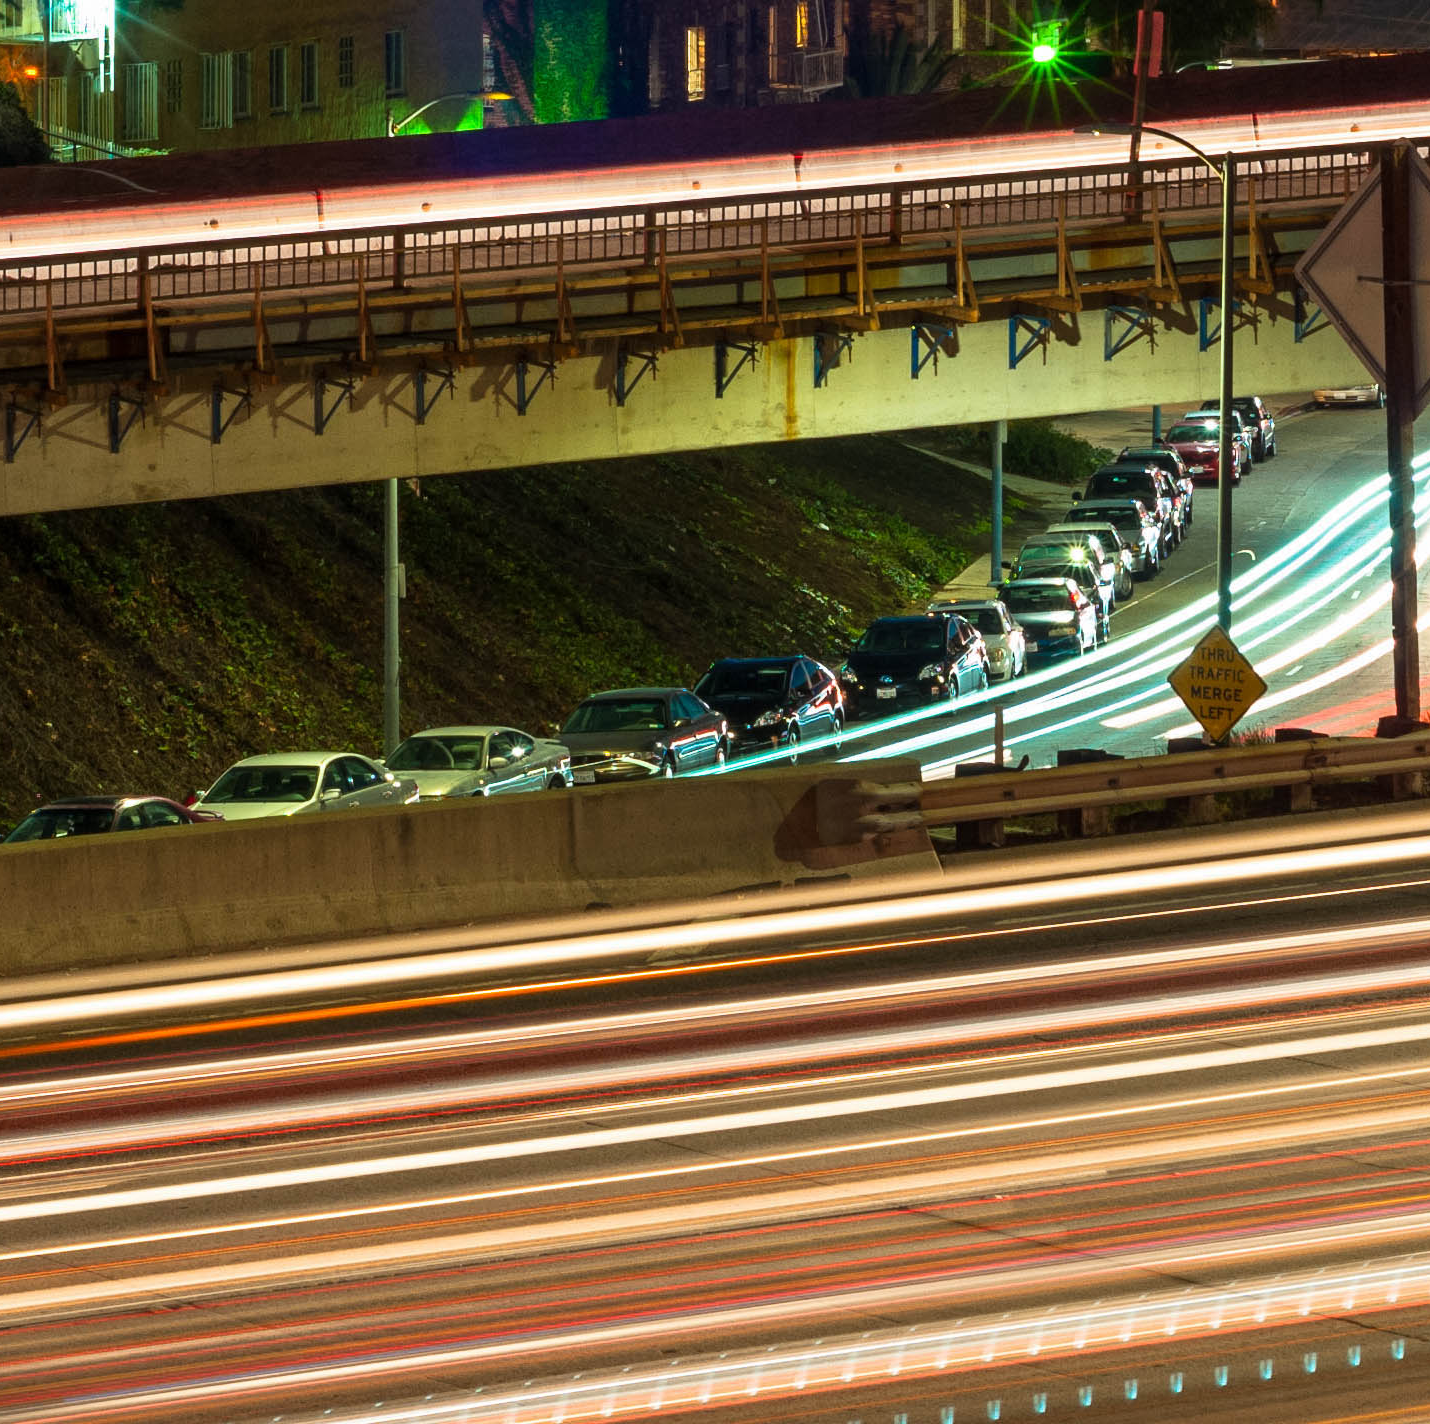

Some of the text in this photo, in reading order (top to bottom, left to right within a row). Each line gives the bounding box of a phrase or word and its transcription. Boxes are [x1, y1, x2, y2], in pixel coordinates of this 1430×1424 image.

[1200, 647, 1236, 663] THRU
[1190, 665, 1245, 684] TRAFFIC
[1190, 685, 1243, 702] MERGE
[1199, 704, 1235, 721] LEFT
